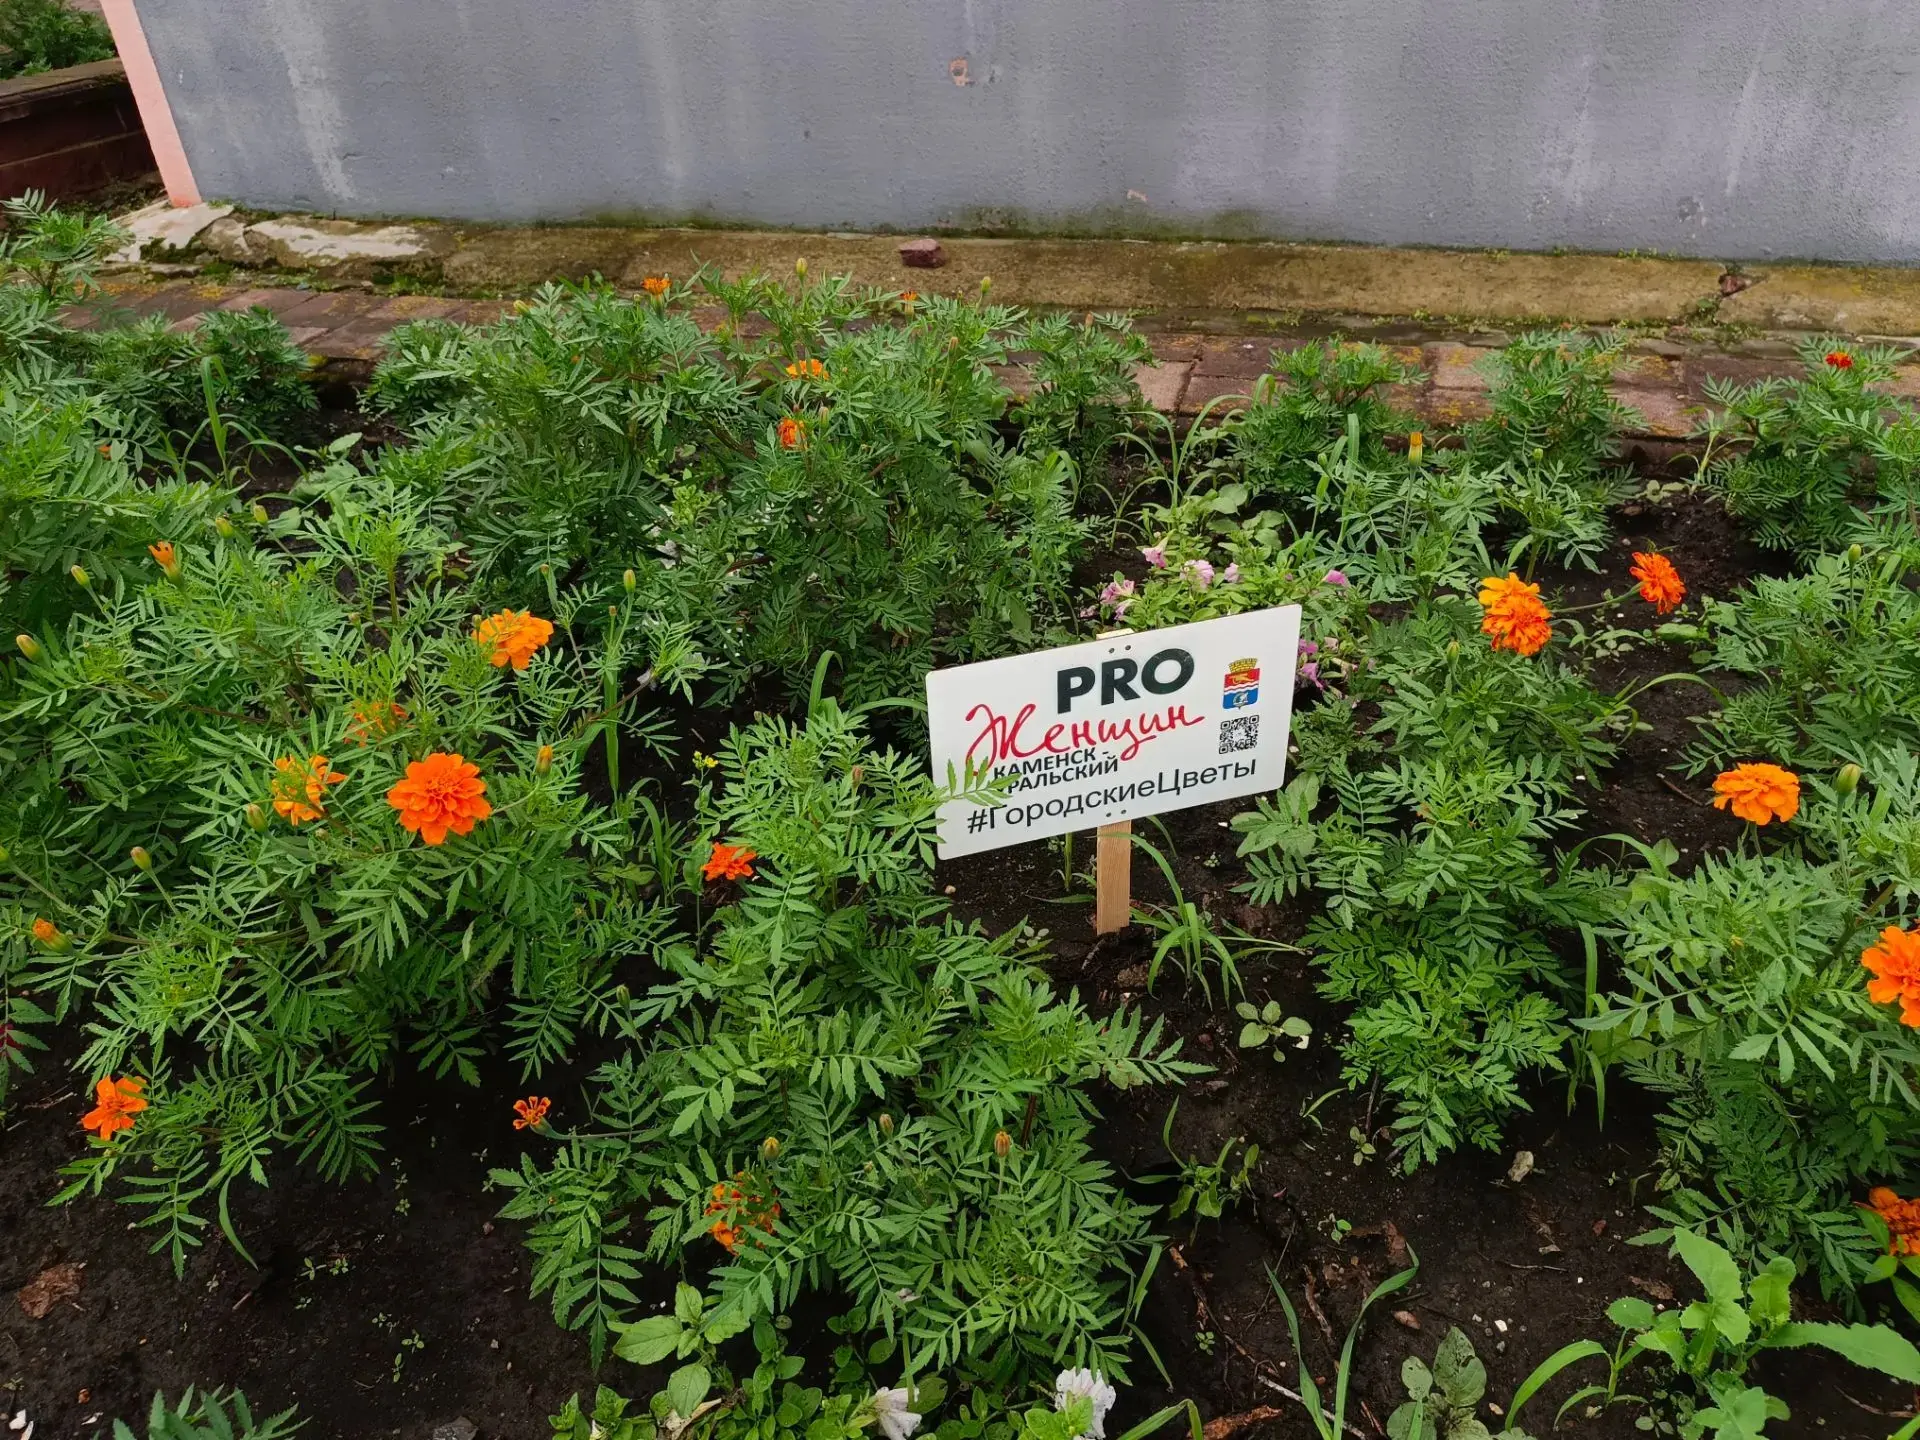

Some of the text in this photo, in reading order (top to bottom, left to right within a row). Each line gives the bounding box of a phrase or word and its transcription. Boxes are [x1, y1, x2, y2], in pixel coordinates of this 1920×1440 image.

[1057, 648, 1195, 714] PRO
[965, 703, 1205, 776] Женщин
[967, 759, 1257, 834] #ГородскиеЦветы
[994, 755, 1118, 794] РАЛЬСКИЙ
